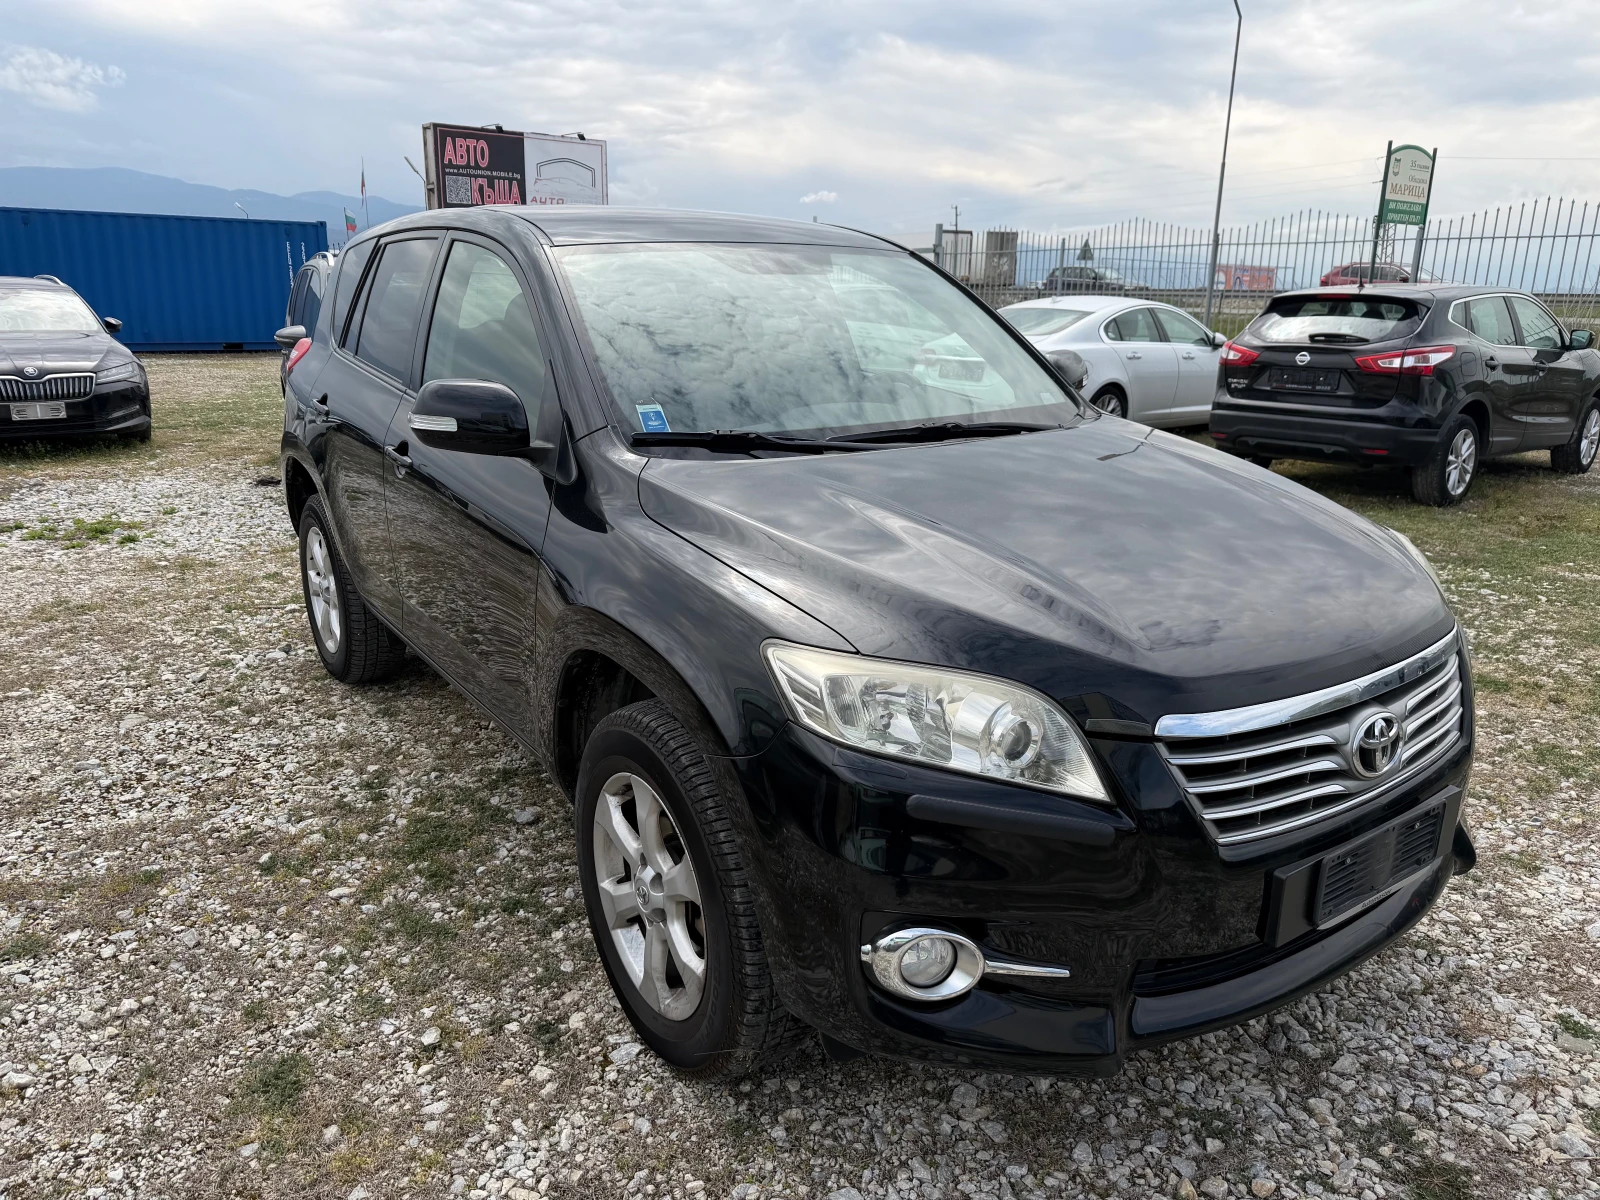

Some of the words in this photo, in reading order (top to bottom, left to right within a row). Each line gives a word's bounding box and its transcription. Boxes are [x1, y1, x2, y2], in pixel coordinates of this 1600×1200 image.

[444, 137, 489, 168] АВТО
[1390, 183, 1425, 199] МАРИЦА
[530, 196, 565, 205] AUTO
